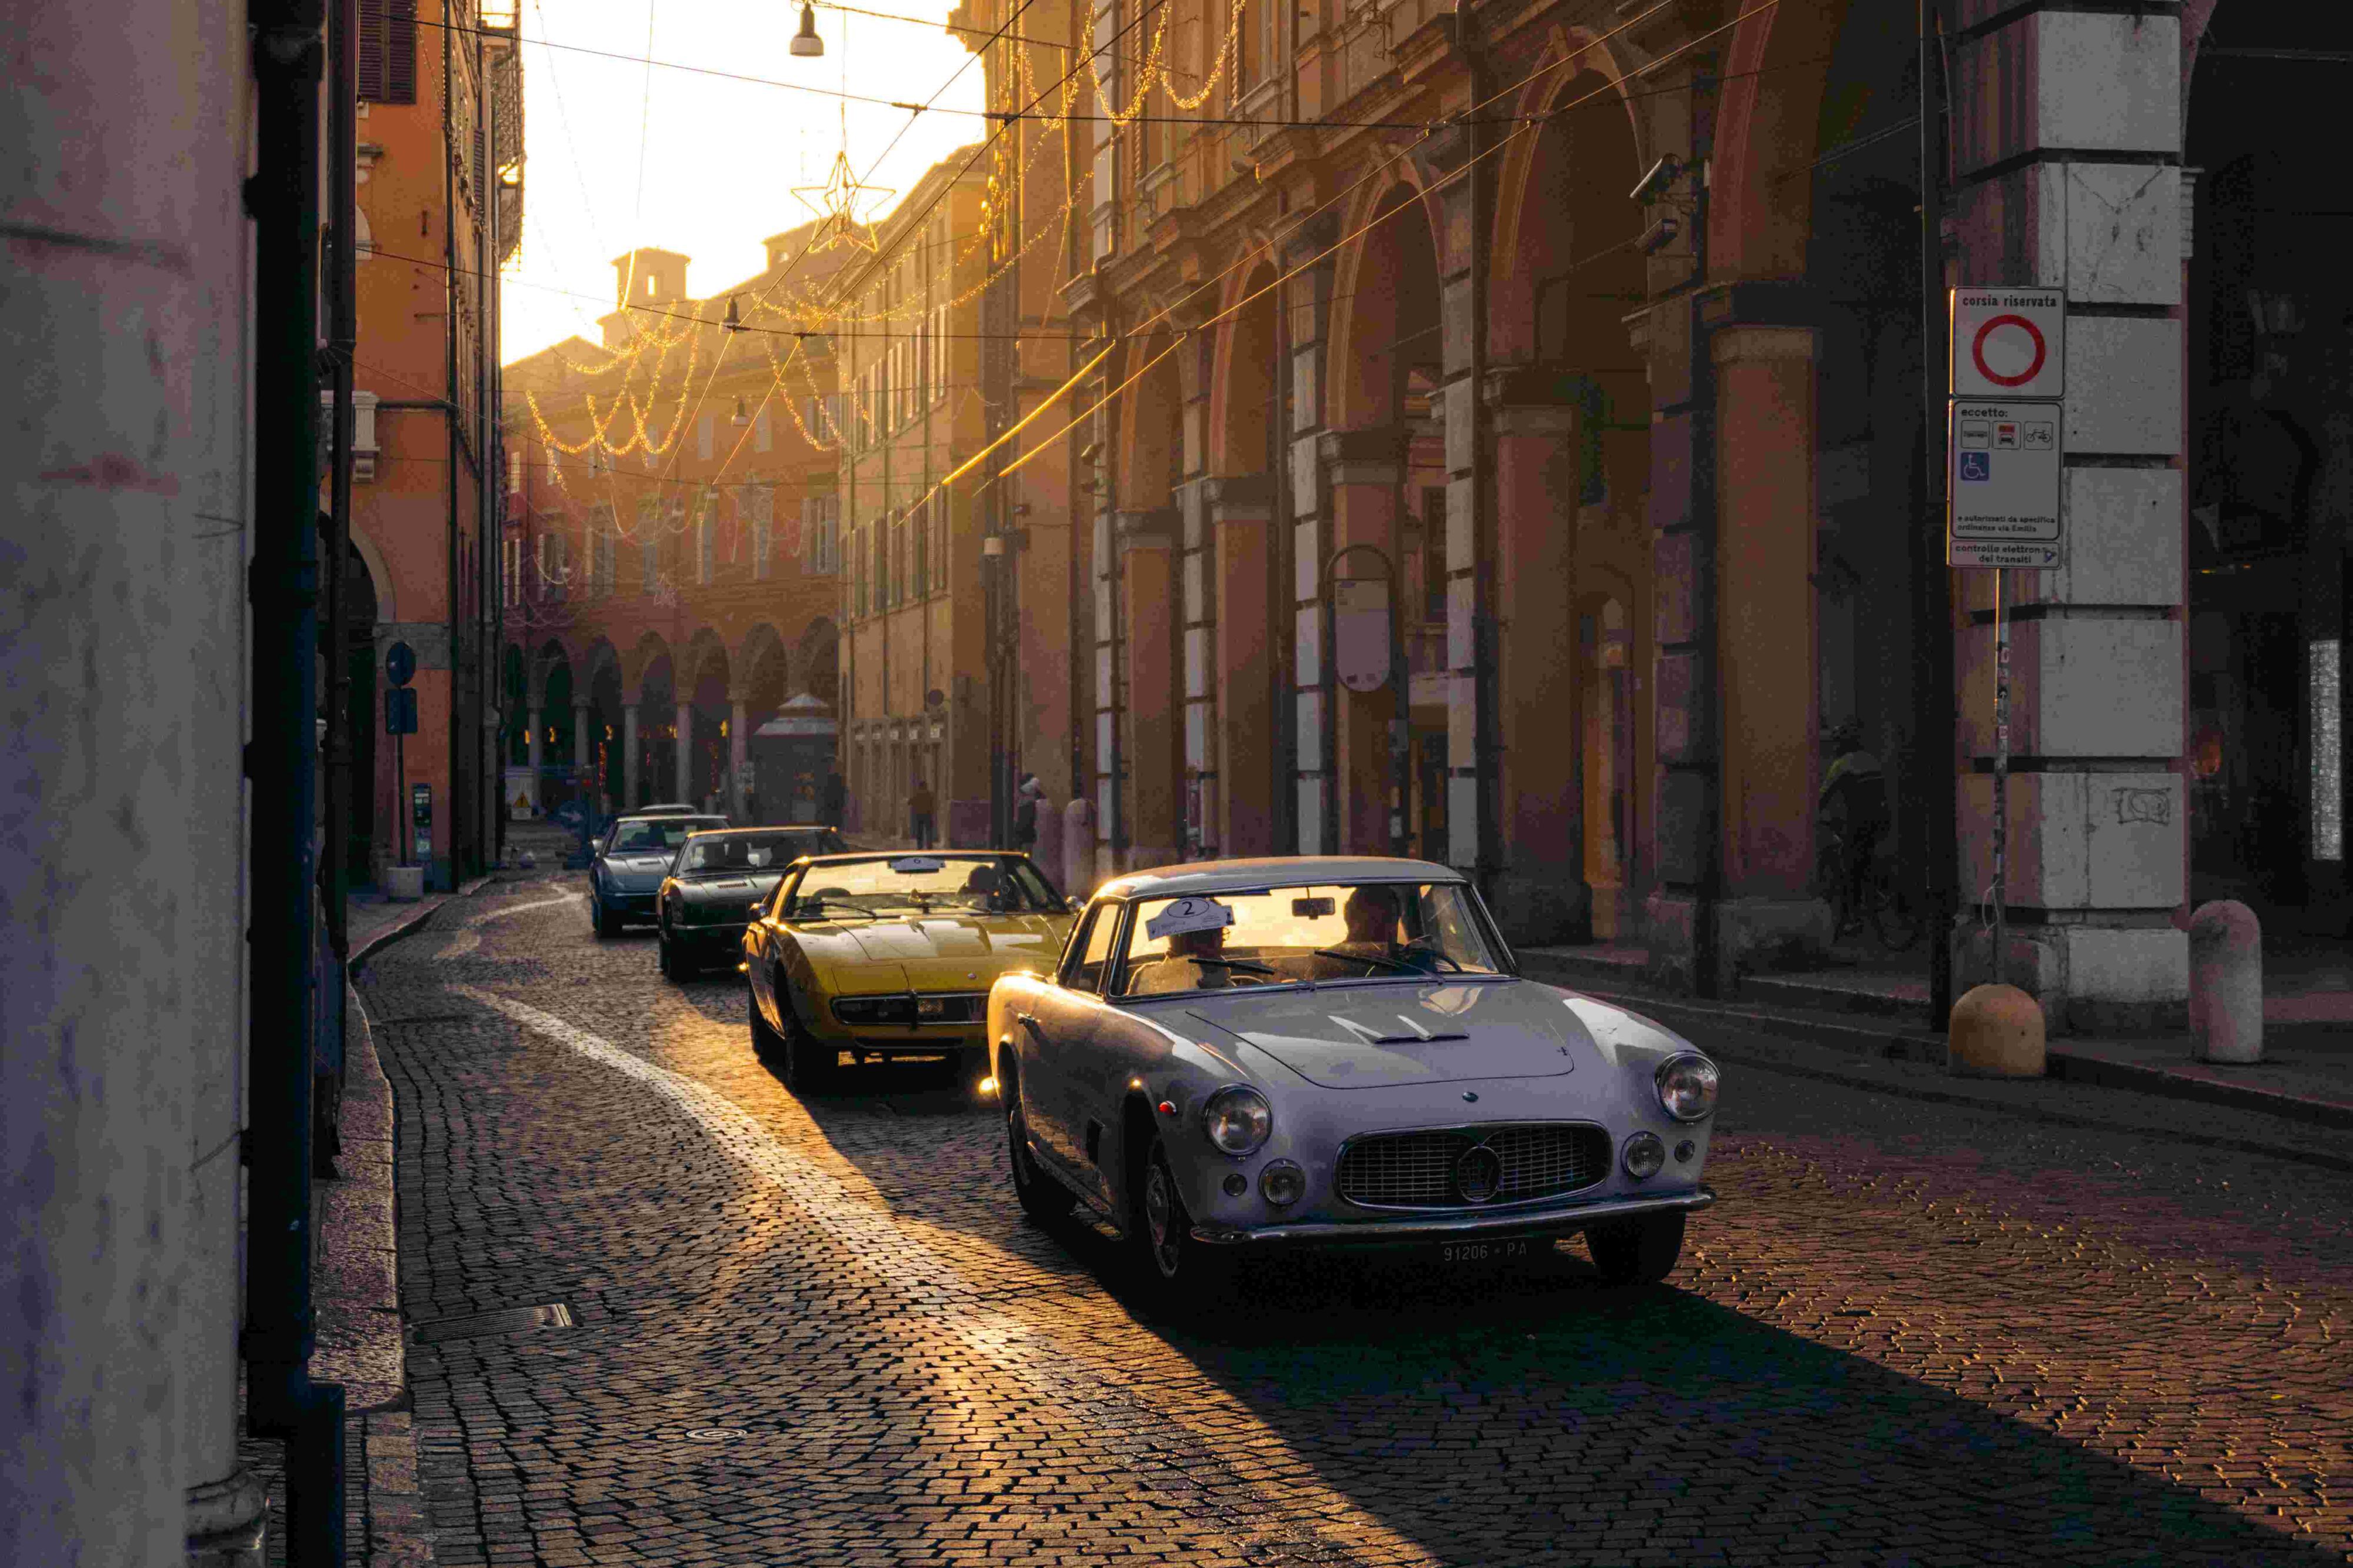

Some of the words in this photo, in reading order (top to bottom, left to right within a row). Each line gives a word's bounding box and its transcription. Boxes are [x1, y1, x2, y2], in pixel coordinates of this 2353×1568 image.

[1962, 295, 1998, 306] corsia
[2004, 295, 2057, 307] riservata
[1961, 408, 2008, 418] eccetto:
[1996, 555, 2031, 563] transiti
[1181, 901, 1196, 915] 2
[1444, 1245, 1488, 1262] 91206
